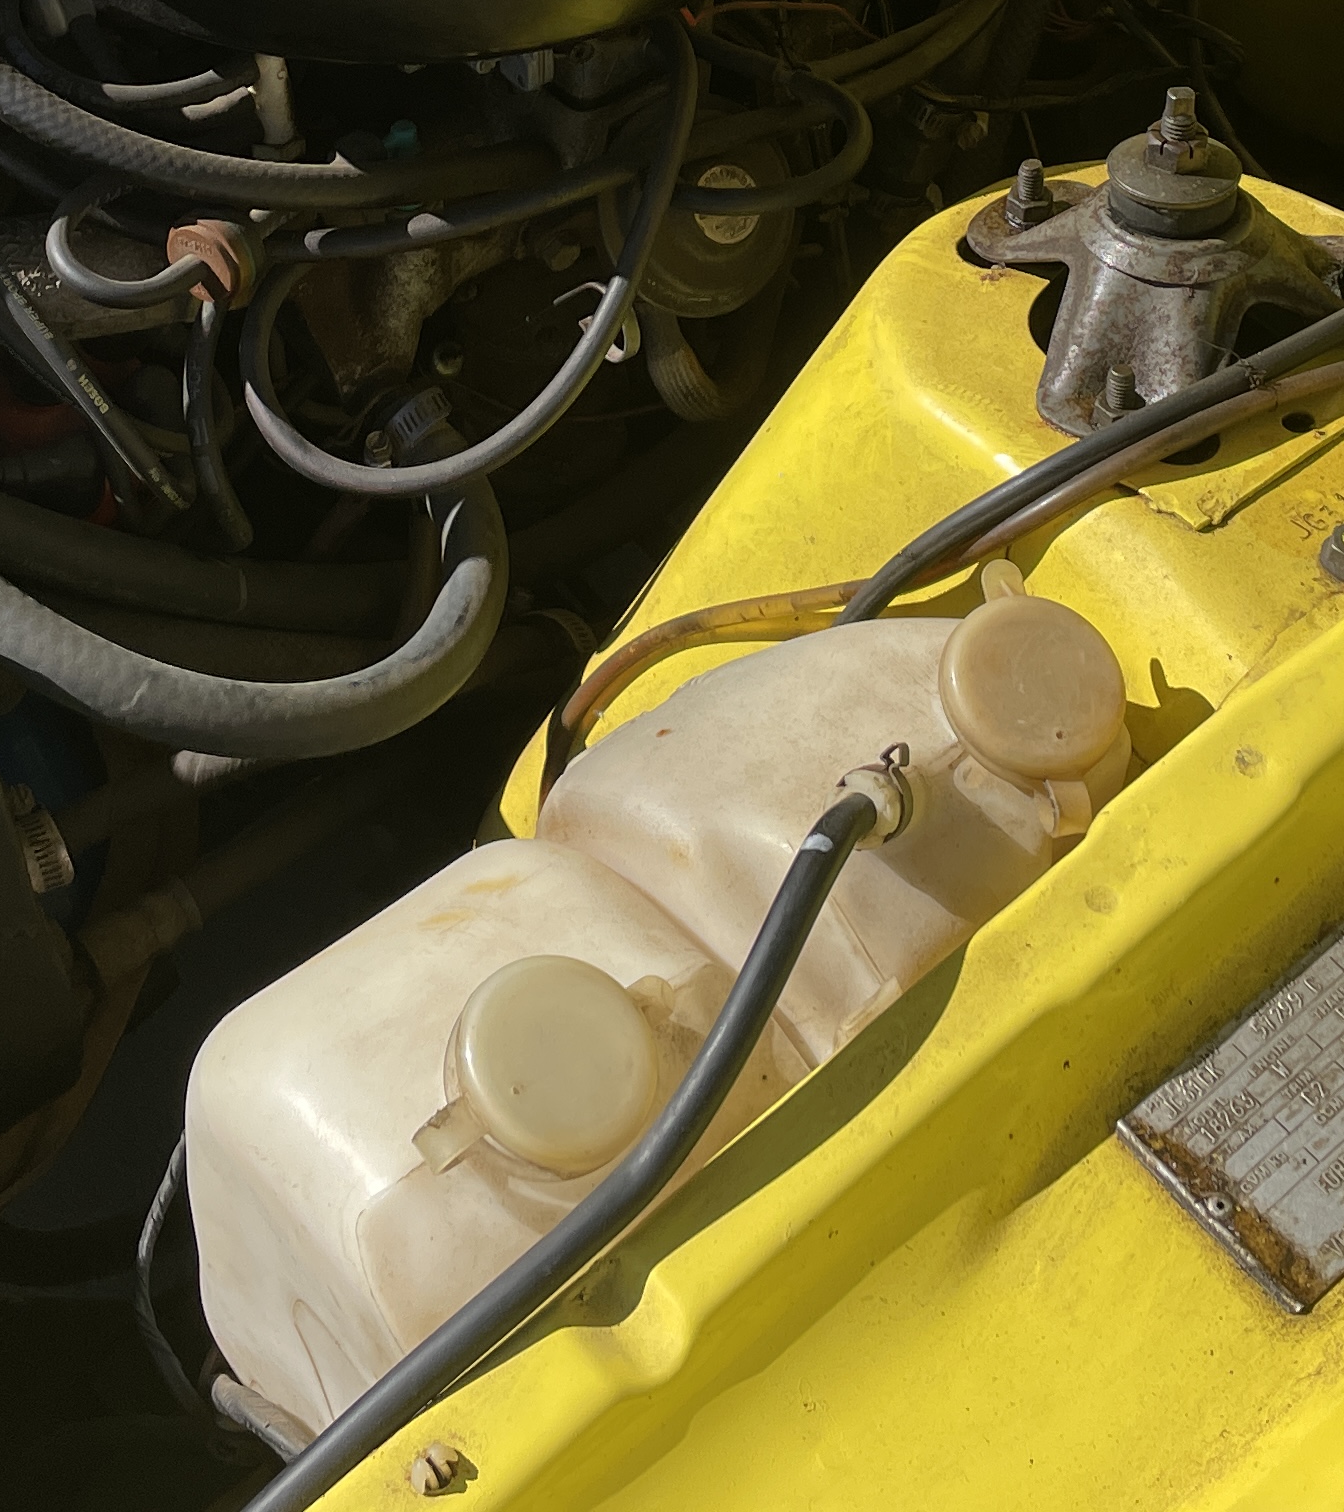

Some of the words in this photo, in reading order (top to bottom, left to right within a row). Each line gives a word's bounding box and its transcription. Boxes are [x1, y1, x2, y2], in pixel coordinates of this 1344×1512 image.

[22, 306, 54, 341] SUPER
[78, 374, 110, 414] BOSCH
[1246, 1032, 1296, 1078] ENGINE
[1270, 1058, 1293, 1079] W
[1281, 1068, 1316, 1100] TRIM
[1305, 1083, 1332, 1109] C2
[1181, 1092, 1229, 1136] MODEL
[1237, 1162, 1273, 1195] GVM
